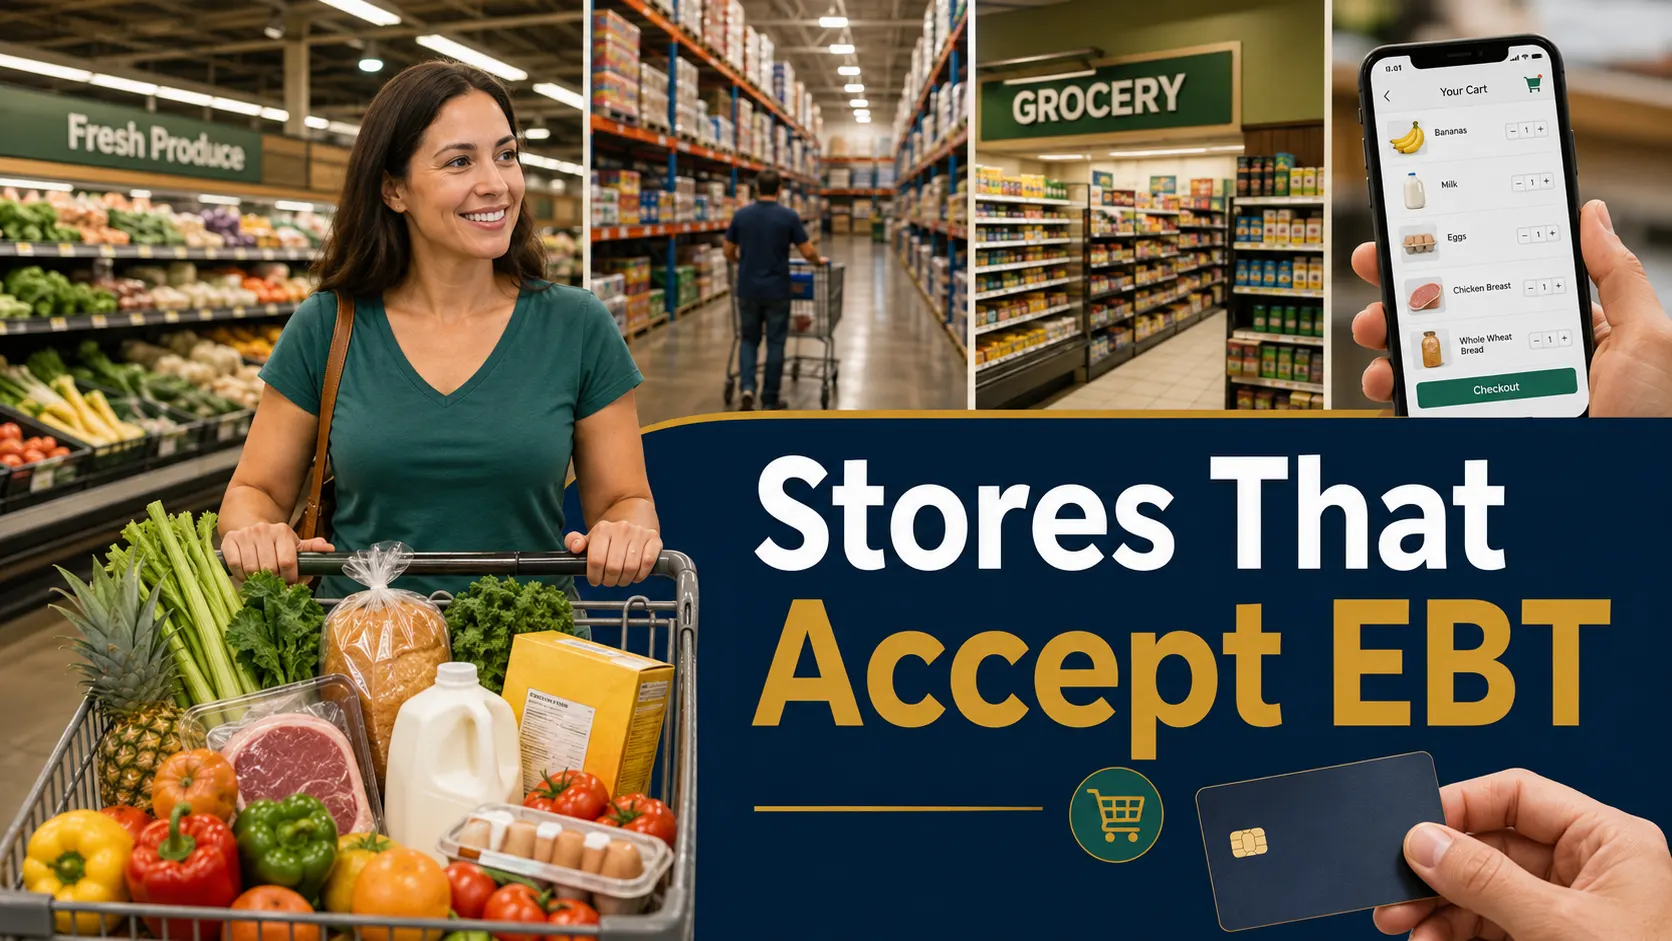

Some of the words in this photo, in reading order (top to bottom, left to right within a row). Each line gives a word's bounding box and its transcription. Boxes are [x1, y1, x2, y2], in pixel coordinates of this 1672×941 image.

[1440, 87, 1464, 97] Your
[1466, 84, 1488, 95] Cart
[1012, 73, 1186, 125] GROCERY
[1434, 127, 1468, 137] Bananas
[68, 112, 145, 159] Fresh
[150, 126, 245, 171] Produce
[1441, 180, 1458, 189] Milk
[1447, 233, 1467, 243] Eggs
[1453, 285, 1485, 295] Chicken
[1486, 282, 1512, 292] Breast
[1459, 335, 1485, 345] Whole
[1486, 333, 1513, 343] Wheat
[1460, 345, 1484, 355] Bread
[1474, 383, 1520, 395] Checkout
